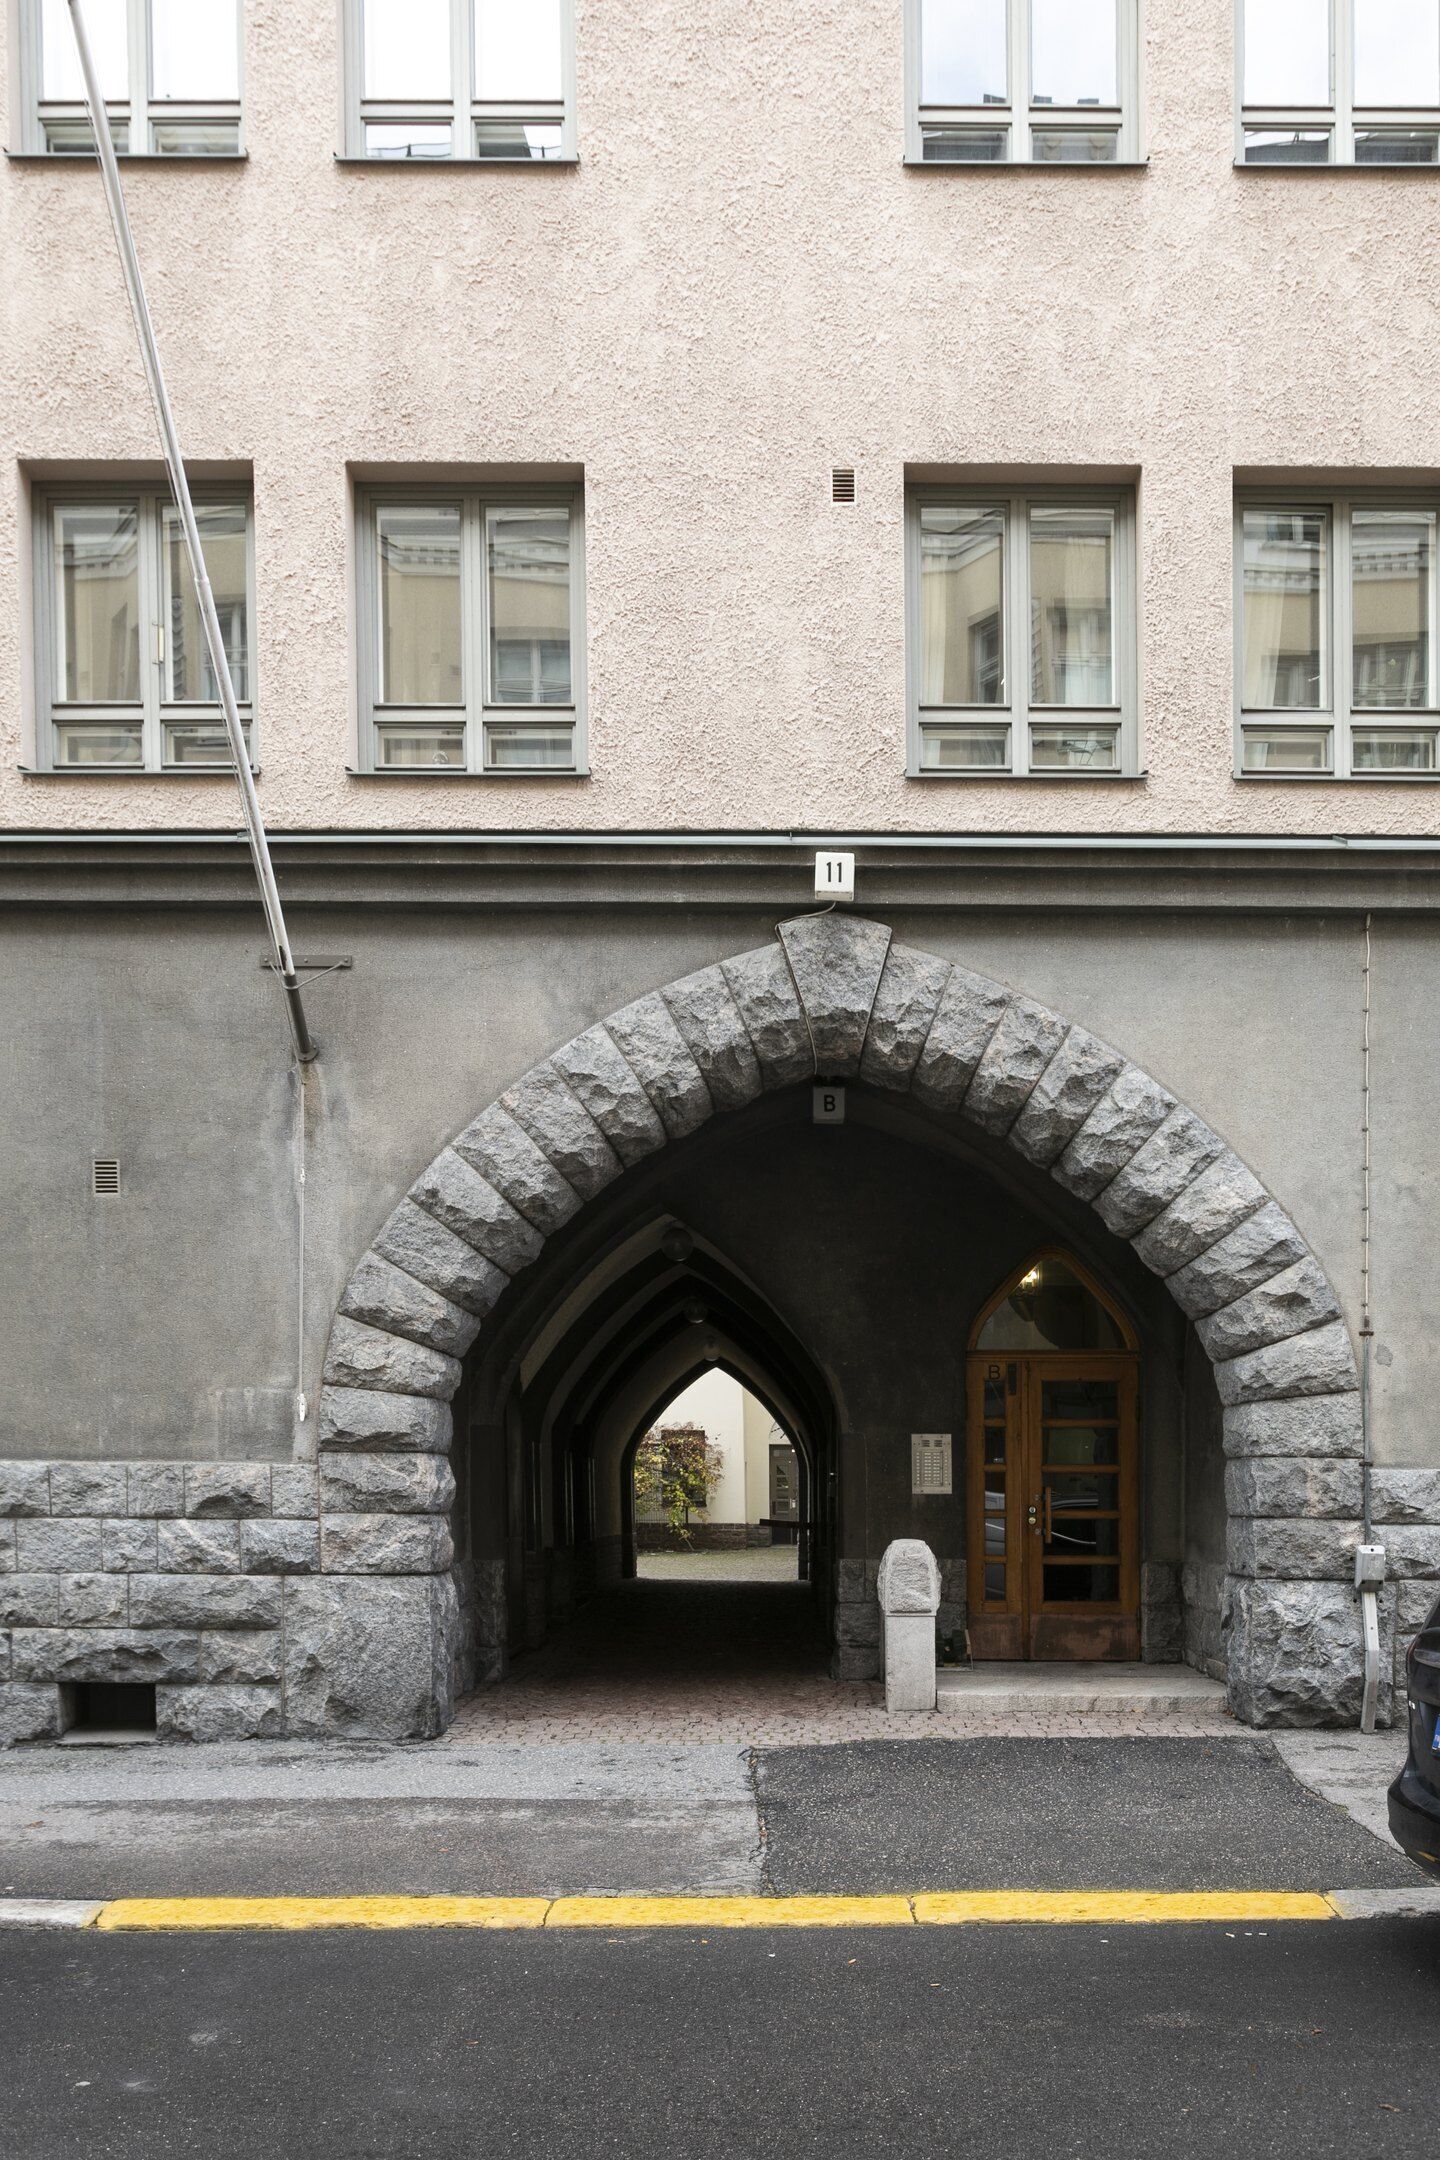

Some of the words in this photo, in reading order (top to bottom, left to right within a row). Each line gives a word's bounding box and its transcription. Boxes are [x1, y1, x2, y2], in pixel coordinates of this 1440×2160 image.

[826, 861, 842, 883] 11
[823, 1094, 836, 1113] B
[988, 1364, 1001, 1380] B
